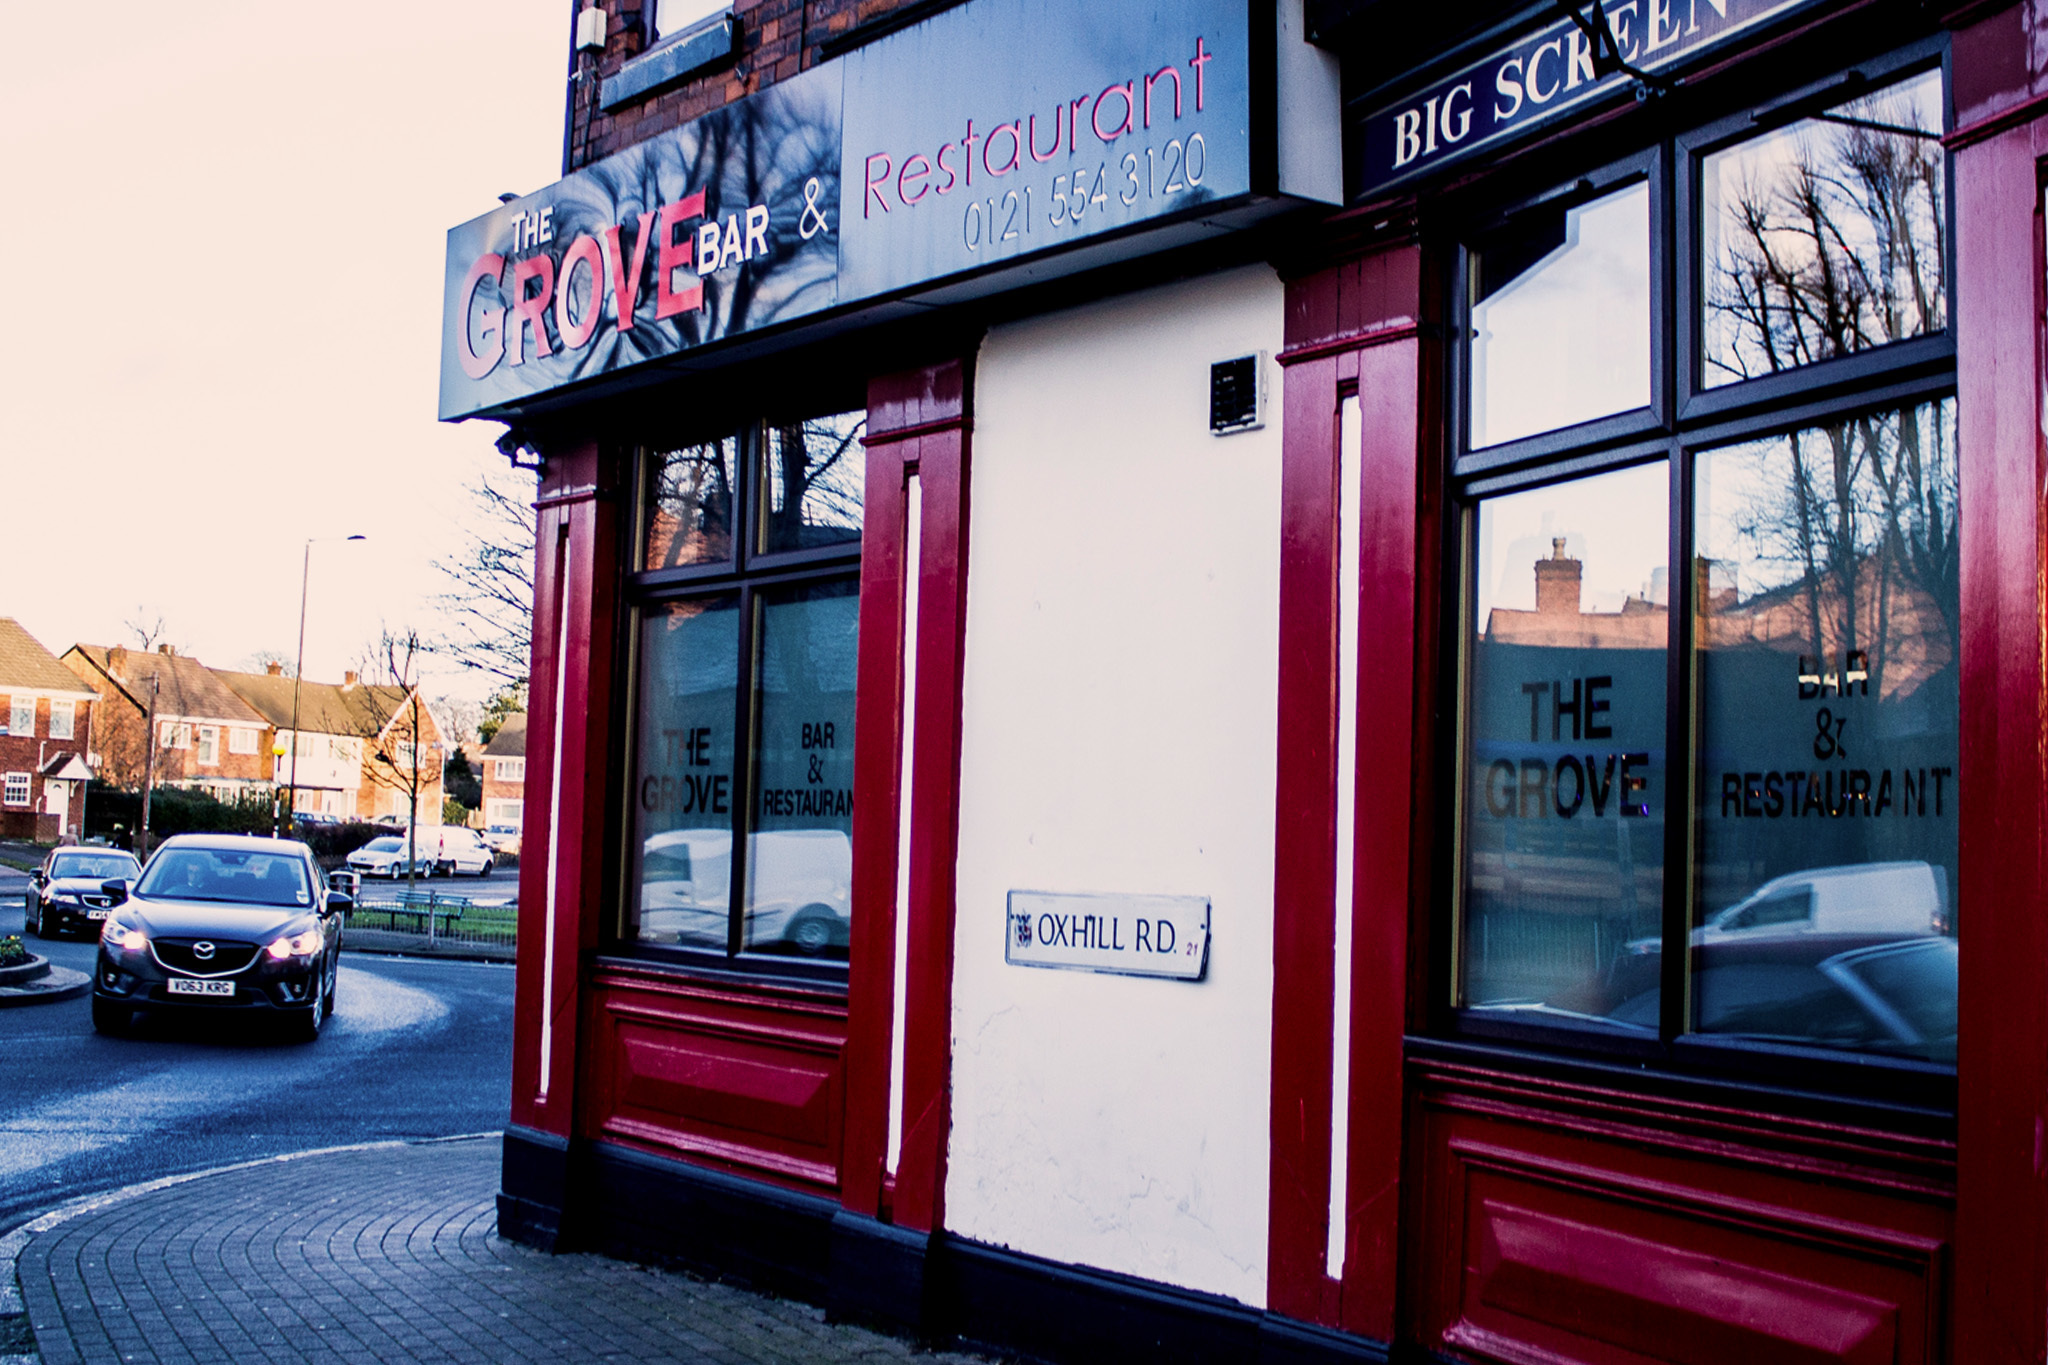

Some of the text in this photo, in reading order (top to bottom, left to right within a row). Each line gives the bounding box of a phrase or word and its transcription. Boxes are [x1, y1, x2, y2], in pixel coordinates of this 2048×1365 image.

[864, 37, 1212, 219] Restaurant
[1391, 81, 1474, 170] BIG
[963, 132, 1206, 252] 0121 554 3120
[511, 206, 555, 253] THE
[457, 177, 829, 380] GROVE BAR &
[1798, 650, 1869, 700] BAR
[1521, 676, 1613, 742] THE
[1813, 707, 1847, 761] &
[662, 727, 711, 768] THE
[801, 722, 835, 750] BAR
[641, 775, 729, 815] GROVE
[807, 754, 824, 784] &
[1486, 752, 1651, 819] GROVE
[1722, 766, 1952, 818] RESTAURANT
[1038, 913, 1199, 956] OXHILL RD. 21
